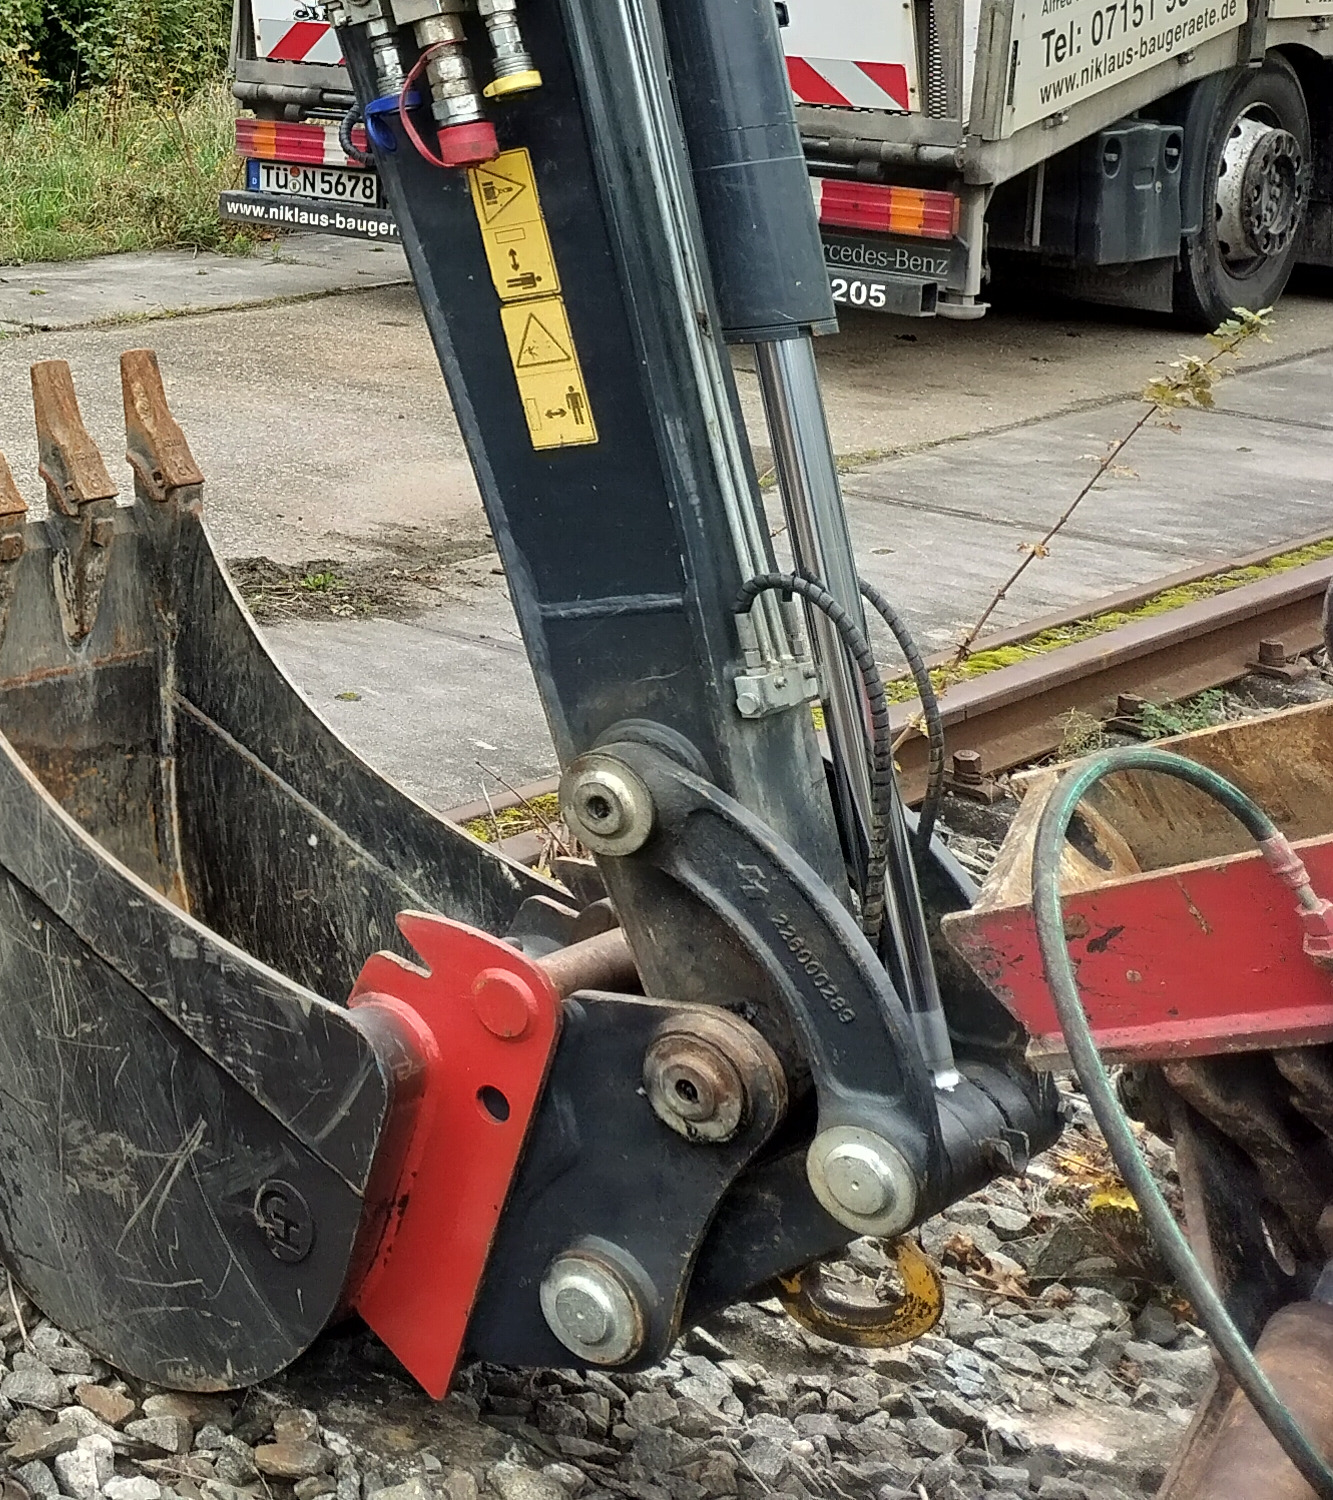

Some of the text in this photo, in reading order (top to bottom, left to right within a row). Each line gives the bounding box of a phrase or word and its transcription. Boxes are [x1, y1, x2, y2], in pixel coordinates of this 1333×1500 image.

[1041, 21, 1081, 68] Tel:
[261, 164, 288, 190] TÜ
[320, 172, 374, 200] 5678
[227, 201, 400, 237] www.niklaus-bauger
[831, 278, 886, 308] 205
